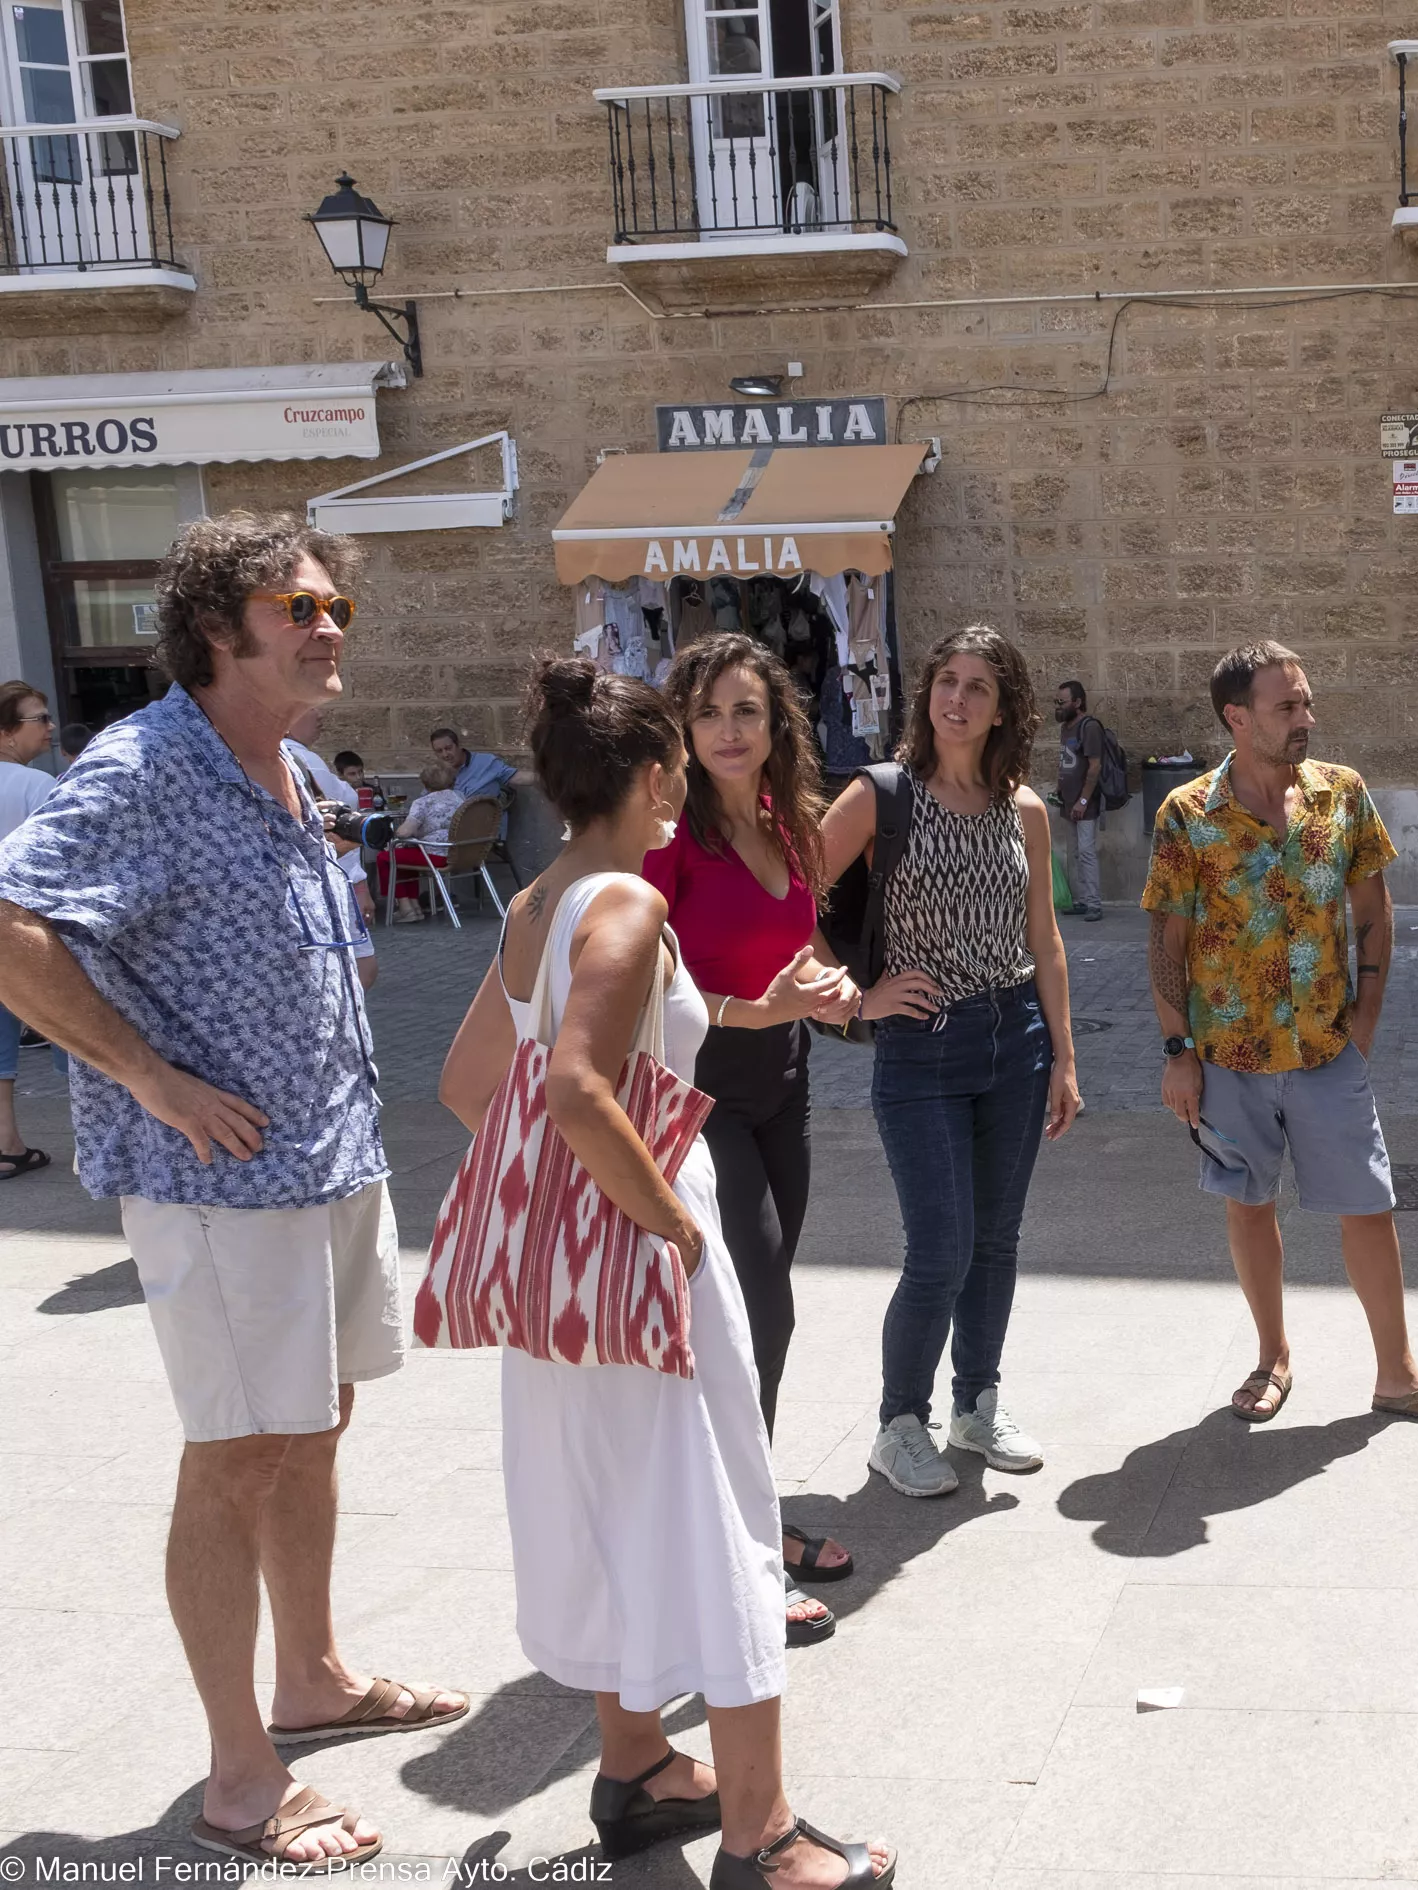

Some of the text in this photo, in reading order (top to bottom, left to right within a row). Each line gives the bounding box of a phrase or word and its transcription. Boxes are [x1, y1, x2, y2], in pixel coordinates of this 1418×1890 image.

[283, 406, 365, 424] Cruzcampo
[302, 427, 352, 439] ESPECIAL
[668, 404, 877, 446] AMALIA
[0, 417, 158, 459] URROS
[643, 536, 802, 573] AMALIA
